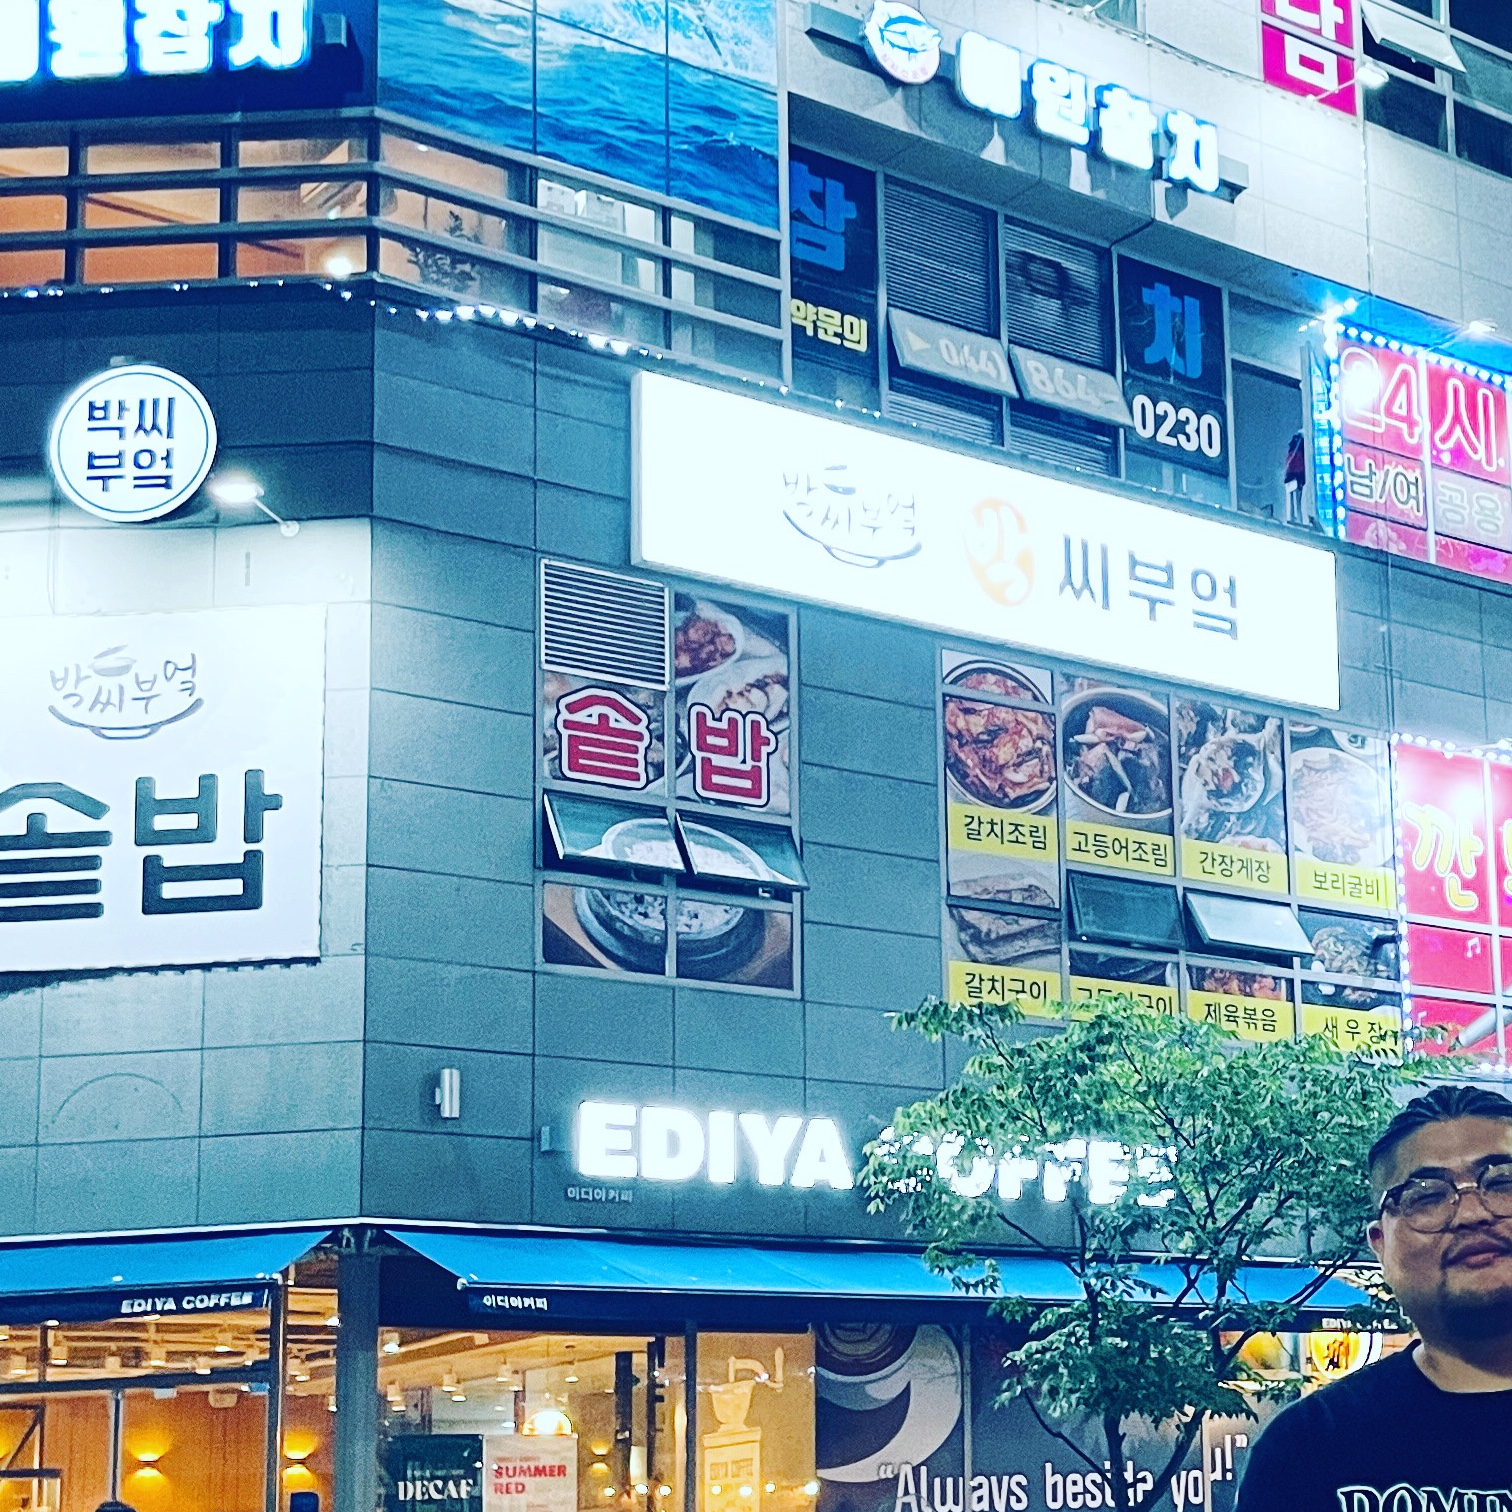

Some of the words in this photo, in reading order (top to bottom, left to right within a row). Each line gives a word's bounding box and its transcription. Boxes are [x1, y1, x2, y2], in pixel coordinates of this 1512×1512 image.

[87, 396, 175, 441] 박씨
[1131, 394, 1221, 460] 0230
[1340, 347, 1500, 473] 24시
[1346, 453, 1424, 518] 남/여
[50, 652, 198, 714] 박씨부엌
[963, 813, 1048, 849] 갈치조림
[1070, 828, 1170, 869] 고등어조림
[1199, 850, 1272, 884] 간장게장
[1312, 869, 1380, 901] 보리굴비
[1203, 1001, 1278, 1033] 제육볶음
[578, 1101, 854, 1190] EDIYA
[121, 1300, 175, 1313] EDIYA
[182, 1293, 253, 1309] COFFEE
[398, 1479, 474, 1501] DECAF
[494, 1465, 567, 1479] SUMMER
[494, 1483, 526, 1495] RED
